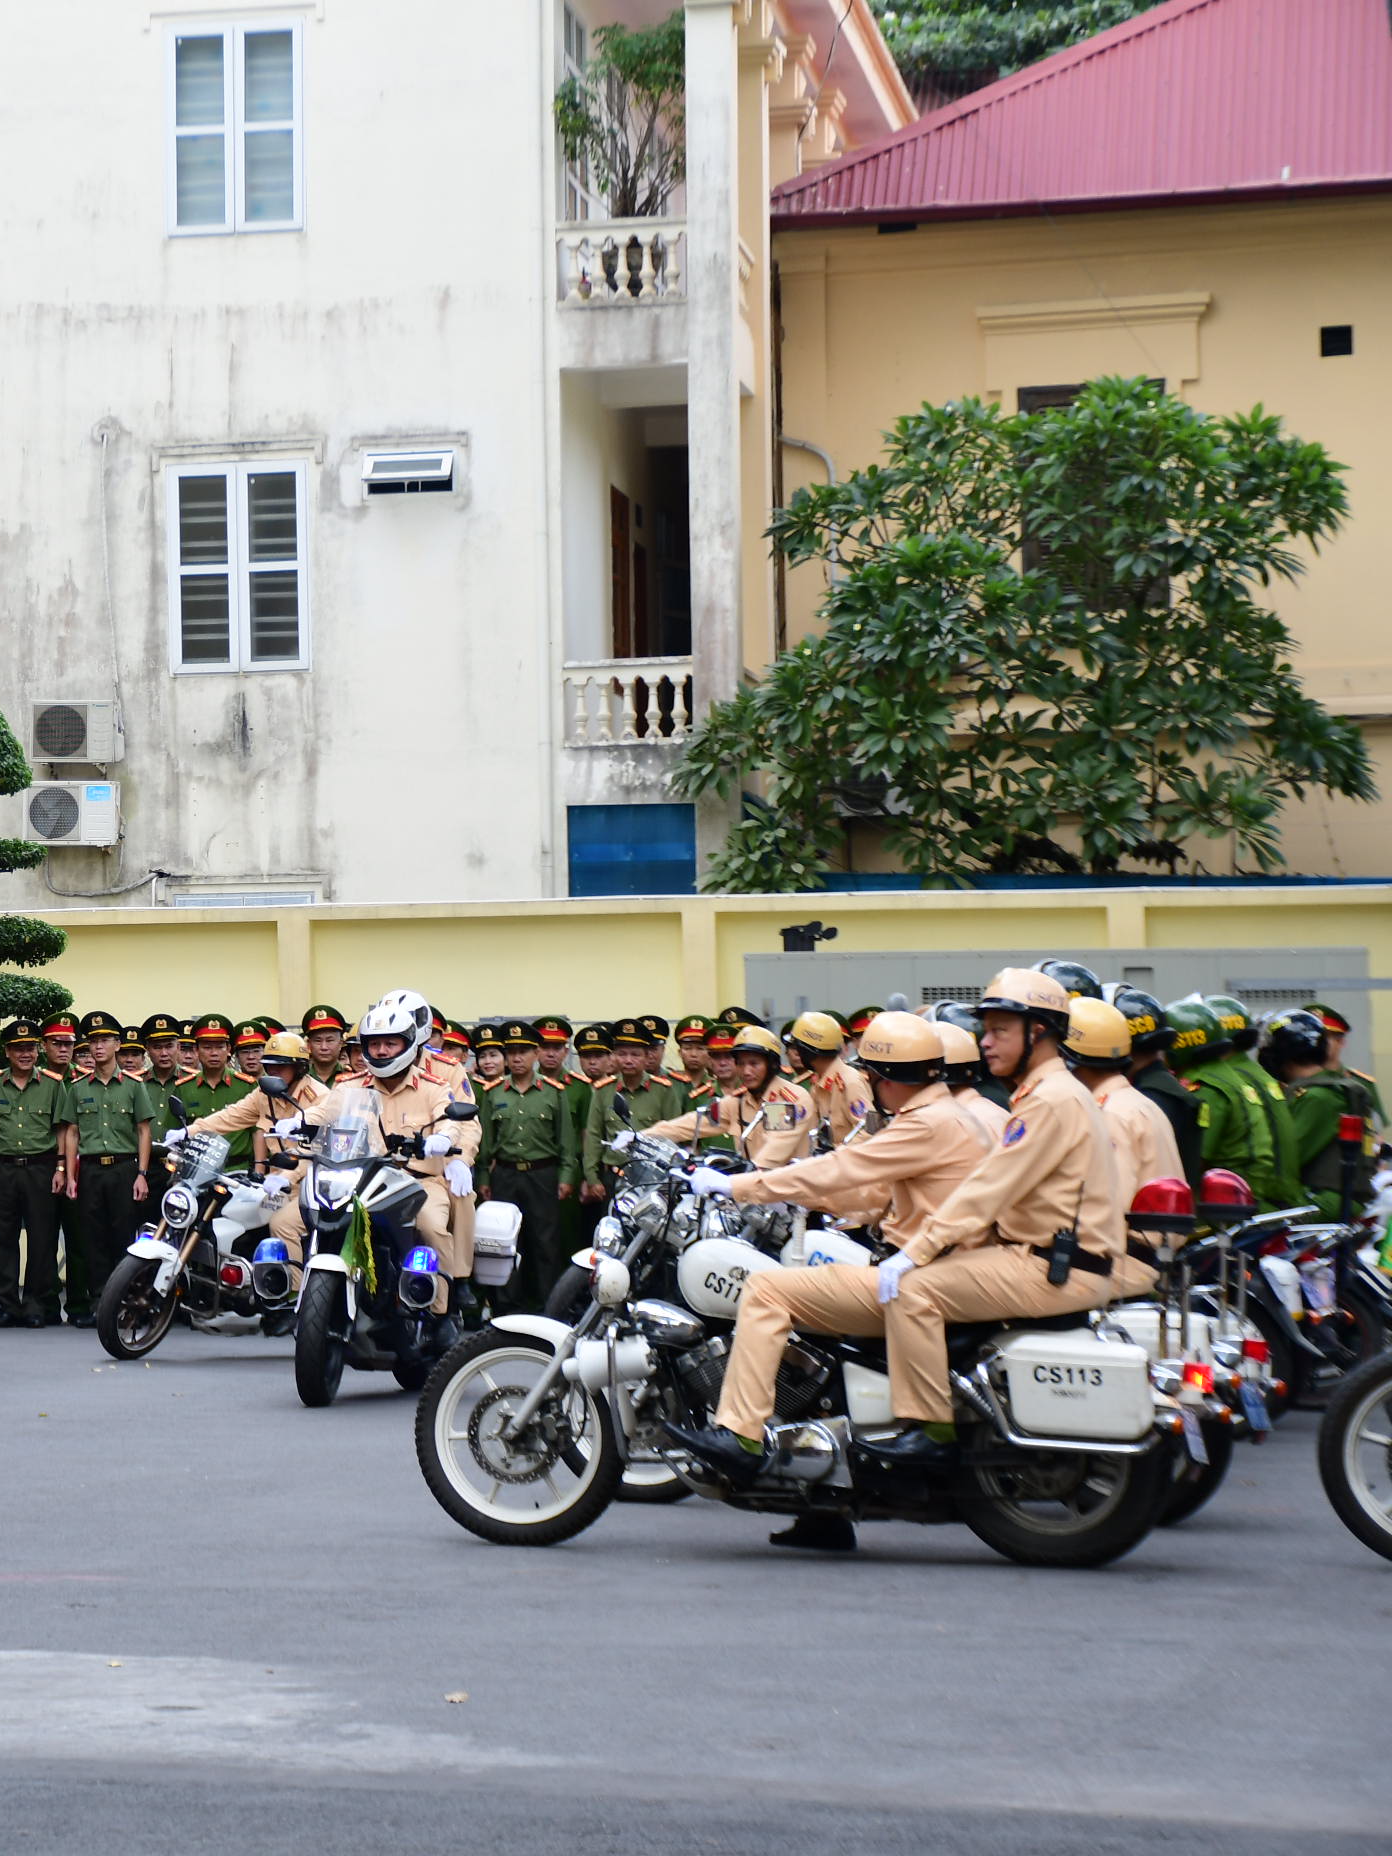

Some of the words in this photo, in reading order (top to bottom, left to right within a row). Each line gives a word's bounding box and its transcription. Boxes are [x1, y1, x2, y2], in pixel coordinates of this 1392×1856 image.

[863, 1041, 893, 1055] CSGT
[194, 1132, 228, 1150] CSGT
[704, 1271, 742, 1304] CS11
[1033, 1365, 1103, 1386] CS113
